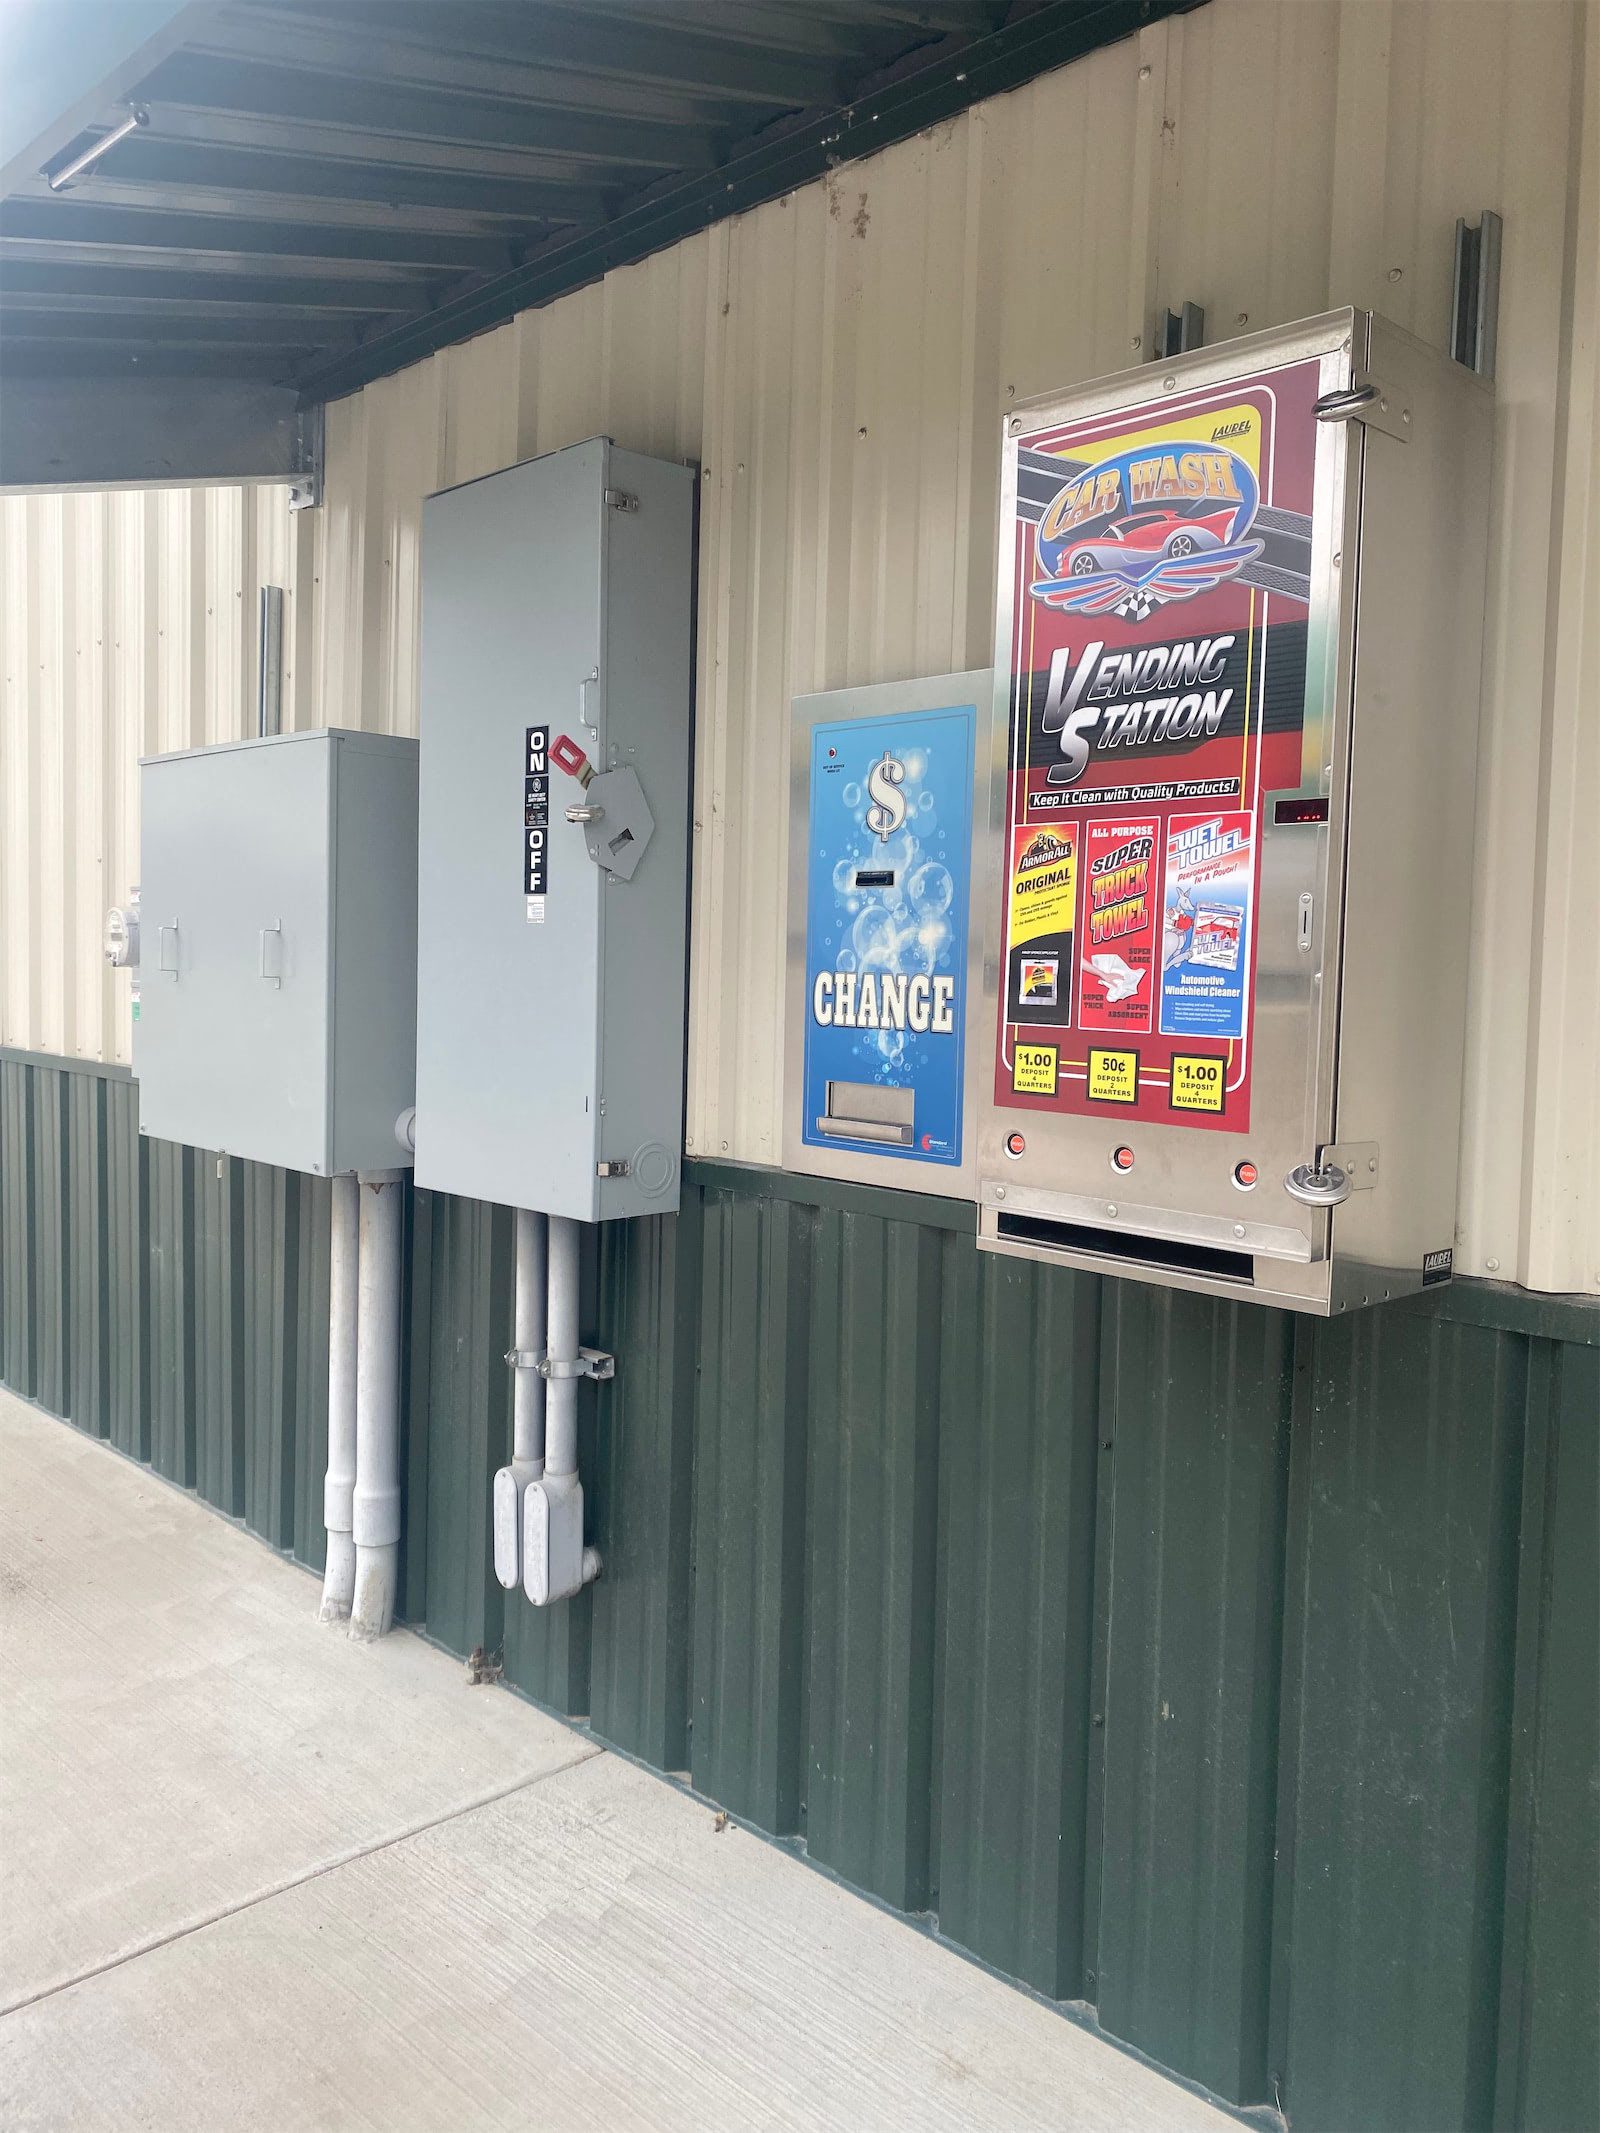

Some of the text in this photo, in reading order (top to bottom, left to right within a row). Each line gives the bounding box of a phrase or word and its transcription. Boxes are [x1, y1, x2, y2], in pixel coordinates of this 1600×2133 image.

[1211, 419, 1251, 441] LAUREL
[1042, 453, 1244, 542] CAR WASH
[1042, 636, 1236, 734] VENDING
[1046, 688, 1234, 784] STATION
[530, 731, 545, 772] ON
[1033, 779, 1235, 807] Keep It Clean with Quality Products!
[1092, 826, 1153, 838] ALL PURPOSE
[1172, 818, 1222, 852] WET
[529, 830, 544, 891] OFF
[1091, 837, 1153, 874] SUPER
[1172, 829, 1244, 870] TOWEL
[1016, 868, 1071, 895] ORIGINAL
[1177, 861, 1221, 882] PERFORMANCE
[1092, 861, 1148, 909] TRUCK
[1091, 897, 1148, 944] TOWEL
[1181, 974, 1225, 986] Automotive
[813, 970, 954, 1033] CHANGE
[1165, 986, 1241, 998] Windshield Cleaner
[1018, 1053, 1052, 1067] $1.00
[1102, 1058, 1126, 1074] 50¢
[1021, 1068, 1049, 1076] DEPOSIT
[1097, 1074, 1128, 1083] DEPOSIT
[1177, 1065, 1218, 1081] $1.00
[1017, 1080, 1052, 1089] QUARTERS
[1092, 1087, 1131, 1097] QUARTERS
[1180, 1082, 1214, 1091] DEPOSIT
[1176, 1096, 1218, 1105] QUARTERS
[1425, 1250, 1451, 1272] LAUREL
